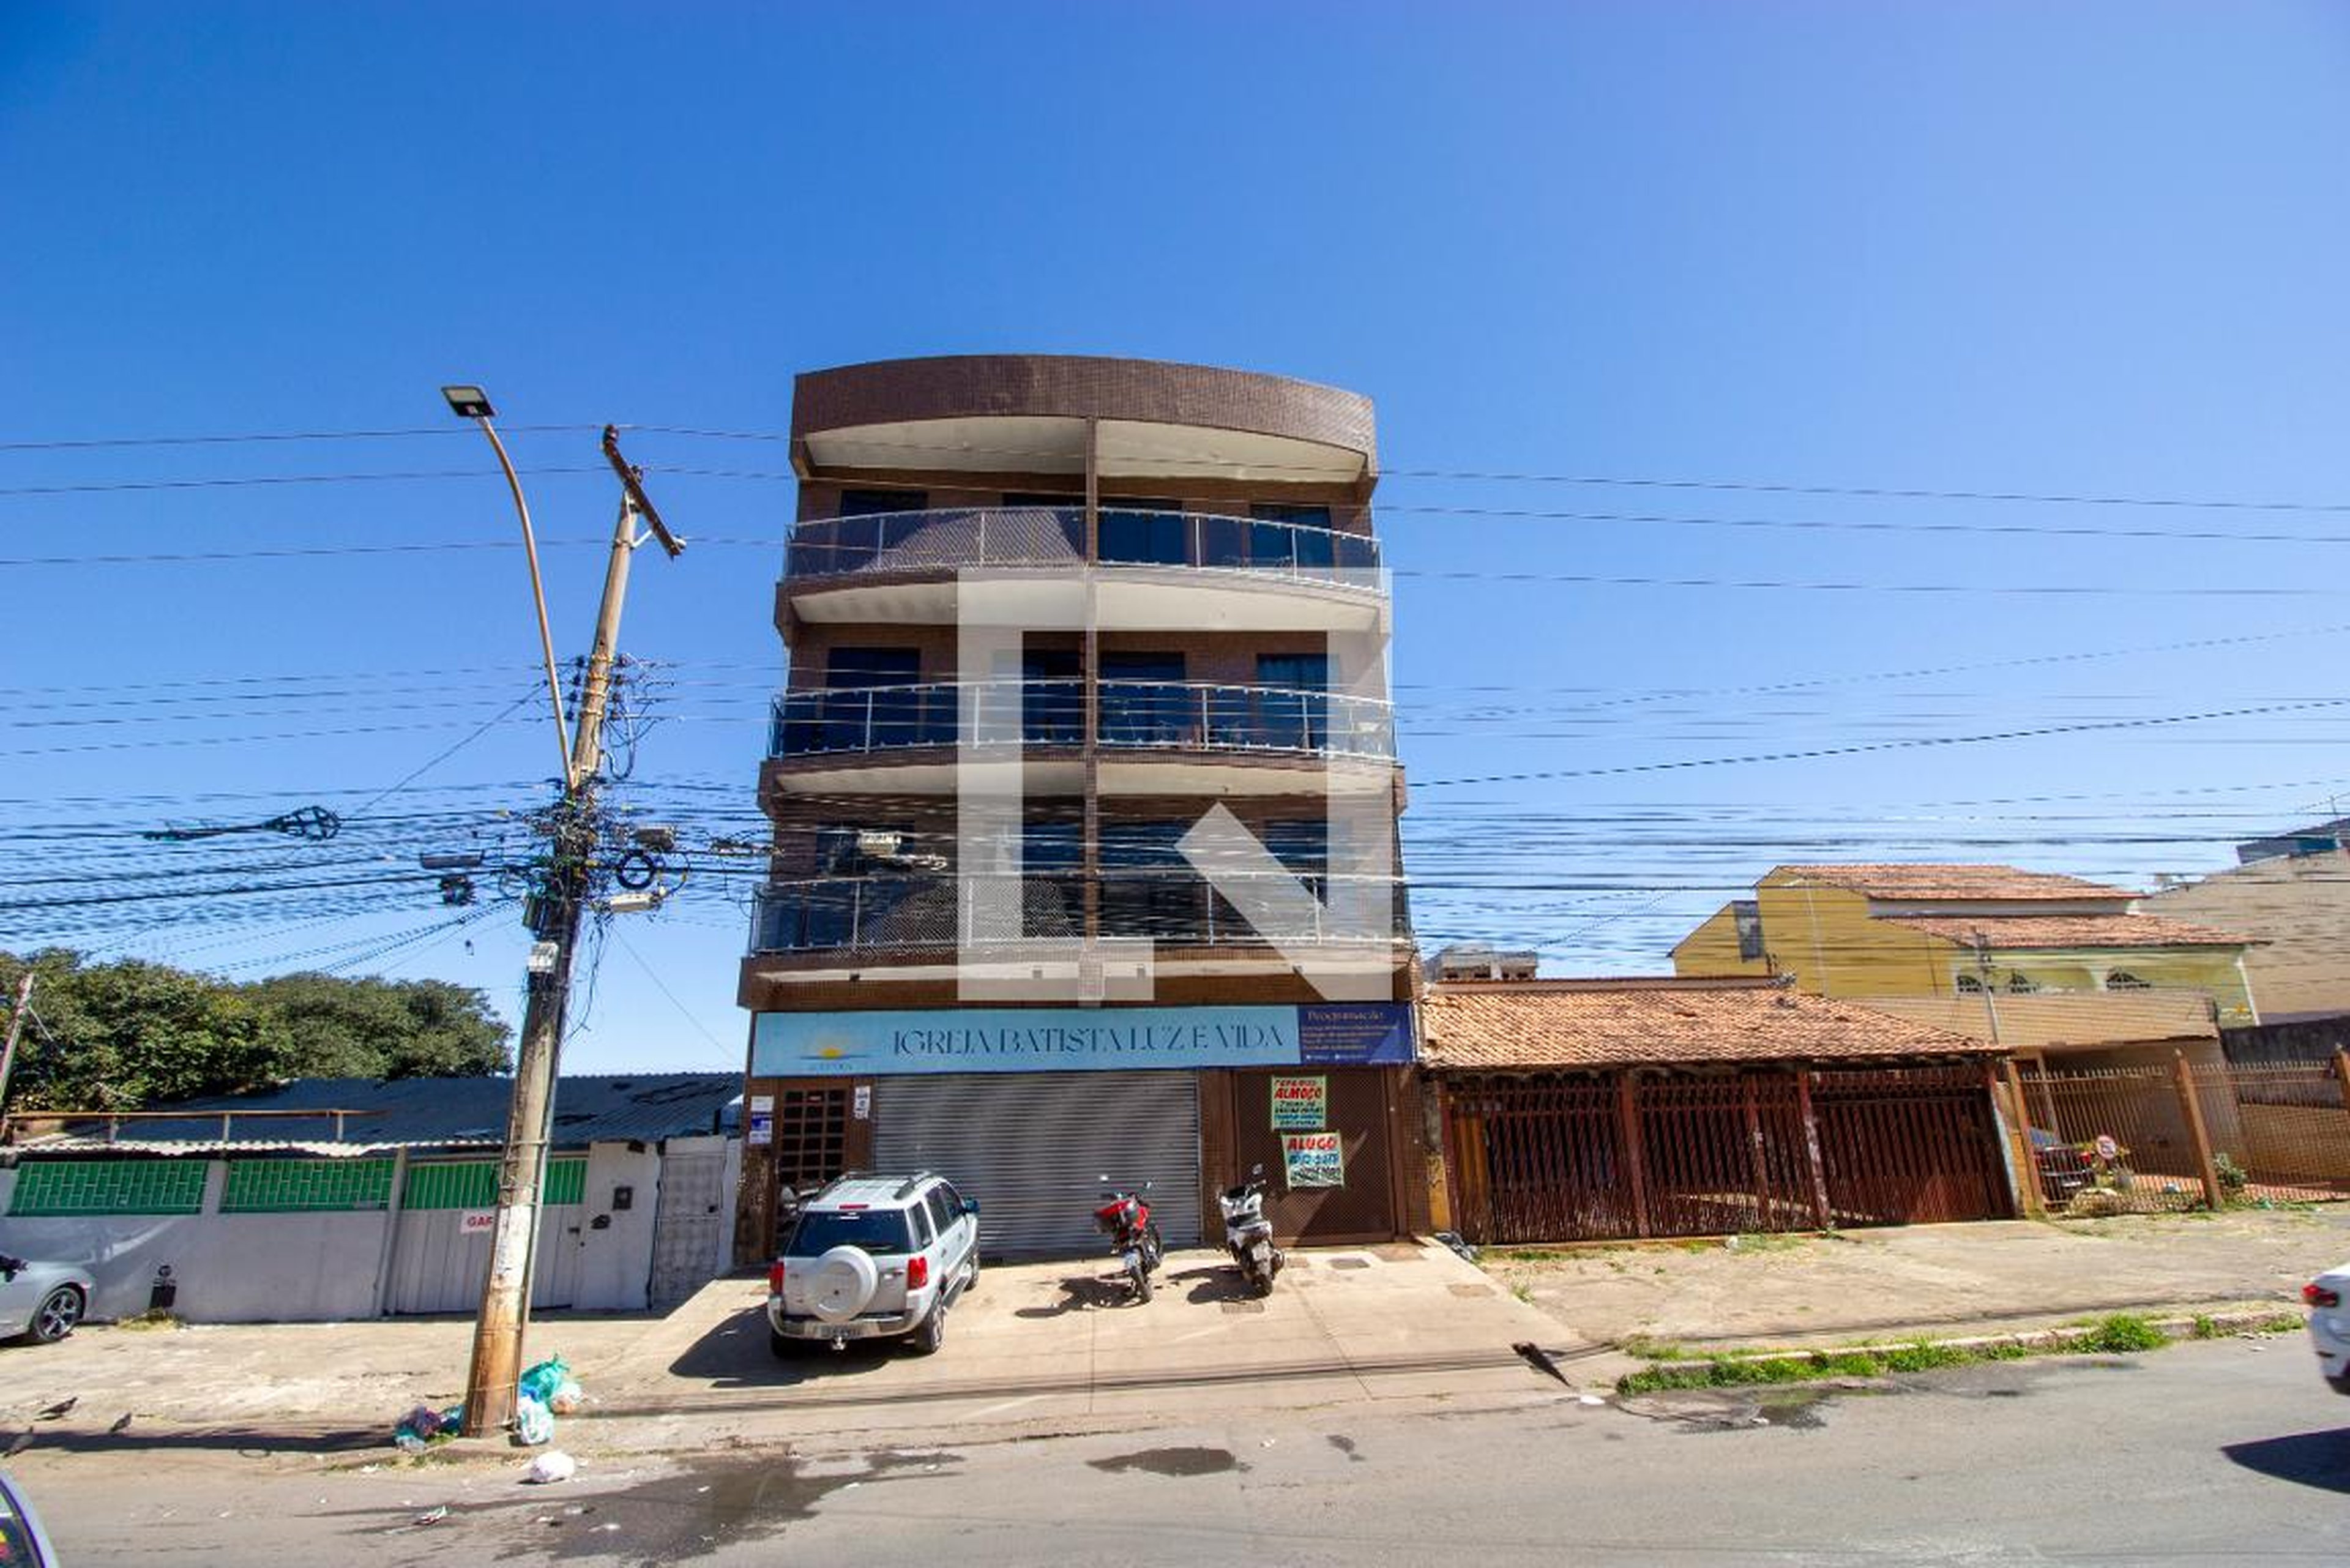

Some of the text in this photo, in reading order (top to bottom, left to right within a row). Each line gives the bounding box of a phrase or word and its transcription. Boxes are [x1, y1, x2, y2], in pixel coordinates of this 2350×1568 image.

[894, 1024, 1283, 1057] IGREJA BATISTA LUZ E VIDA
[1288, 1137, 1337, 1151] ALUGO
